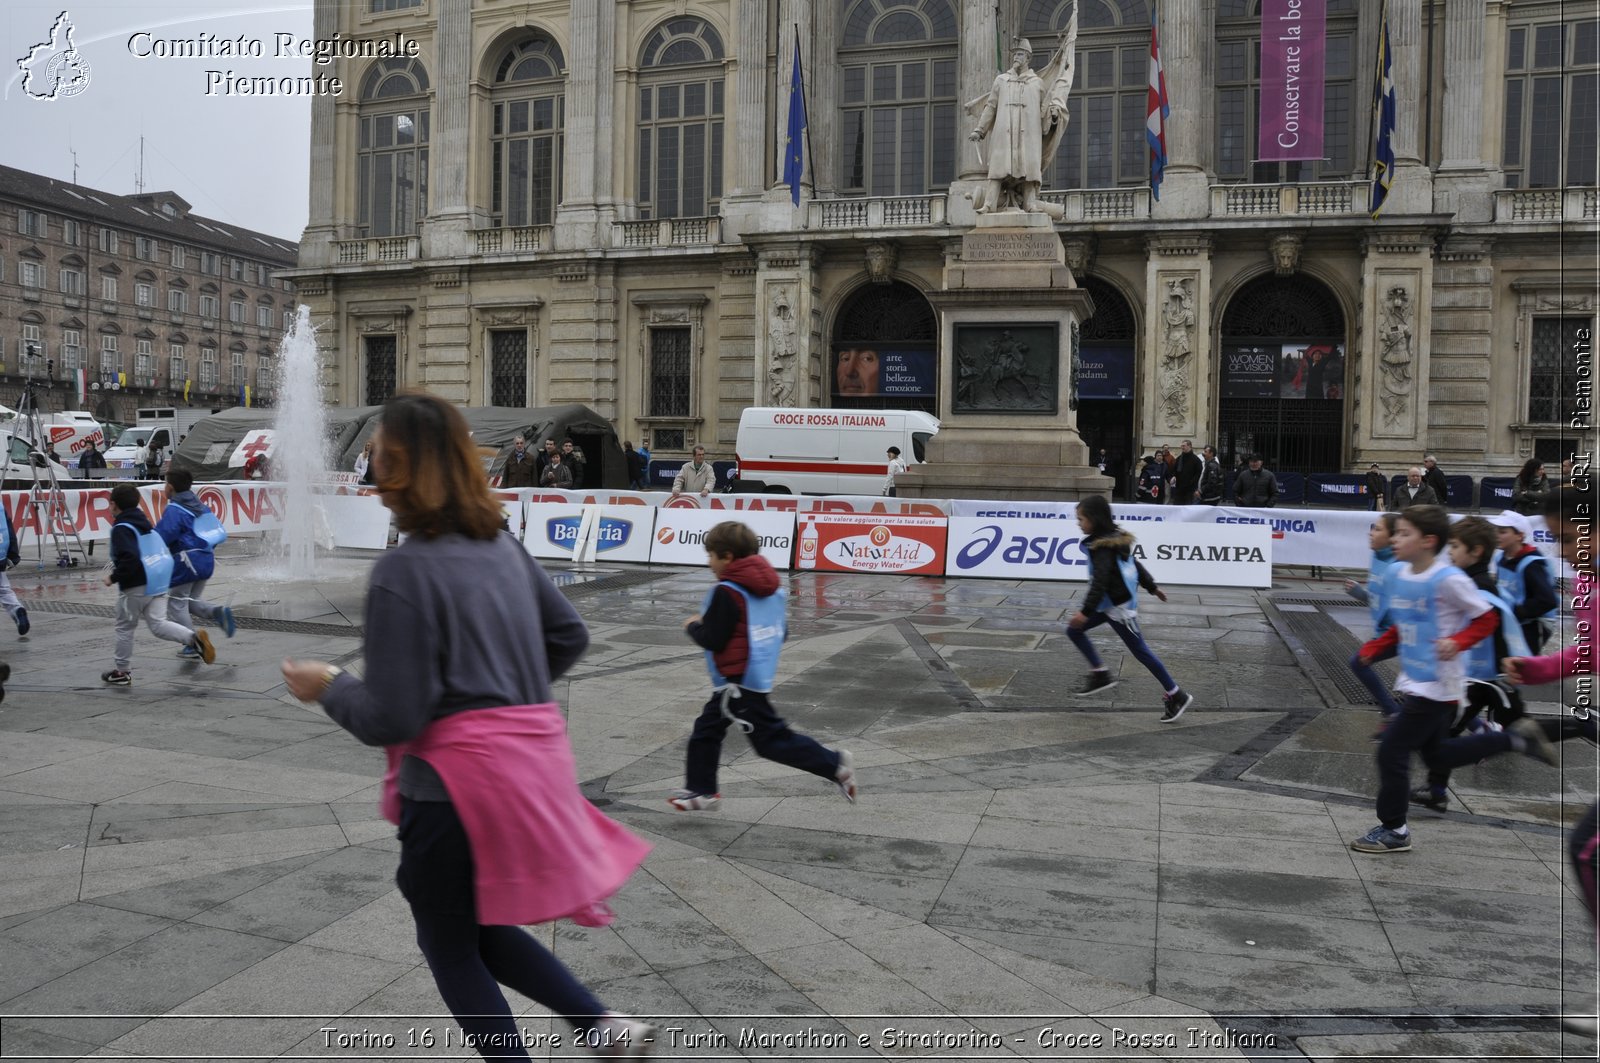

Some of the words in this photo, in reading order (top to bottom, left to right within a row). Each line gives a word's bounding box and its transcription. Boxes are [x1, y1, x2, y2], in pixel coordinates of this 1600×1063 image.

[1279, 25, 1301, 40] la
[1278, 46, 1301, 148] Conservare
[1229, 354, 1275, 364] WOMEN
[886, 363, 907, 372] storia
[1228, 363, 1242, 371] OF
[1243, 363, 1274, 372] VISION
[885, 373, 916, 382] bellezza
[885, 383, 922, 392] emozione
[773, 413, 804, 425] CROCE
[806, 414, 839, 426] ROSSA
[841, 415, 886, 427] ITALIANA
[854, 516, 882, 524] aggiunto
[838, 541, 921, 560] NaturAid
[1156, 544, 1266, 563] STAMPA
[852, 559, 879, 569] Energy
[880, 560, 904, 569] Water
